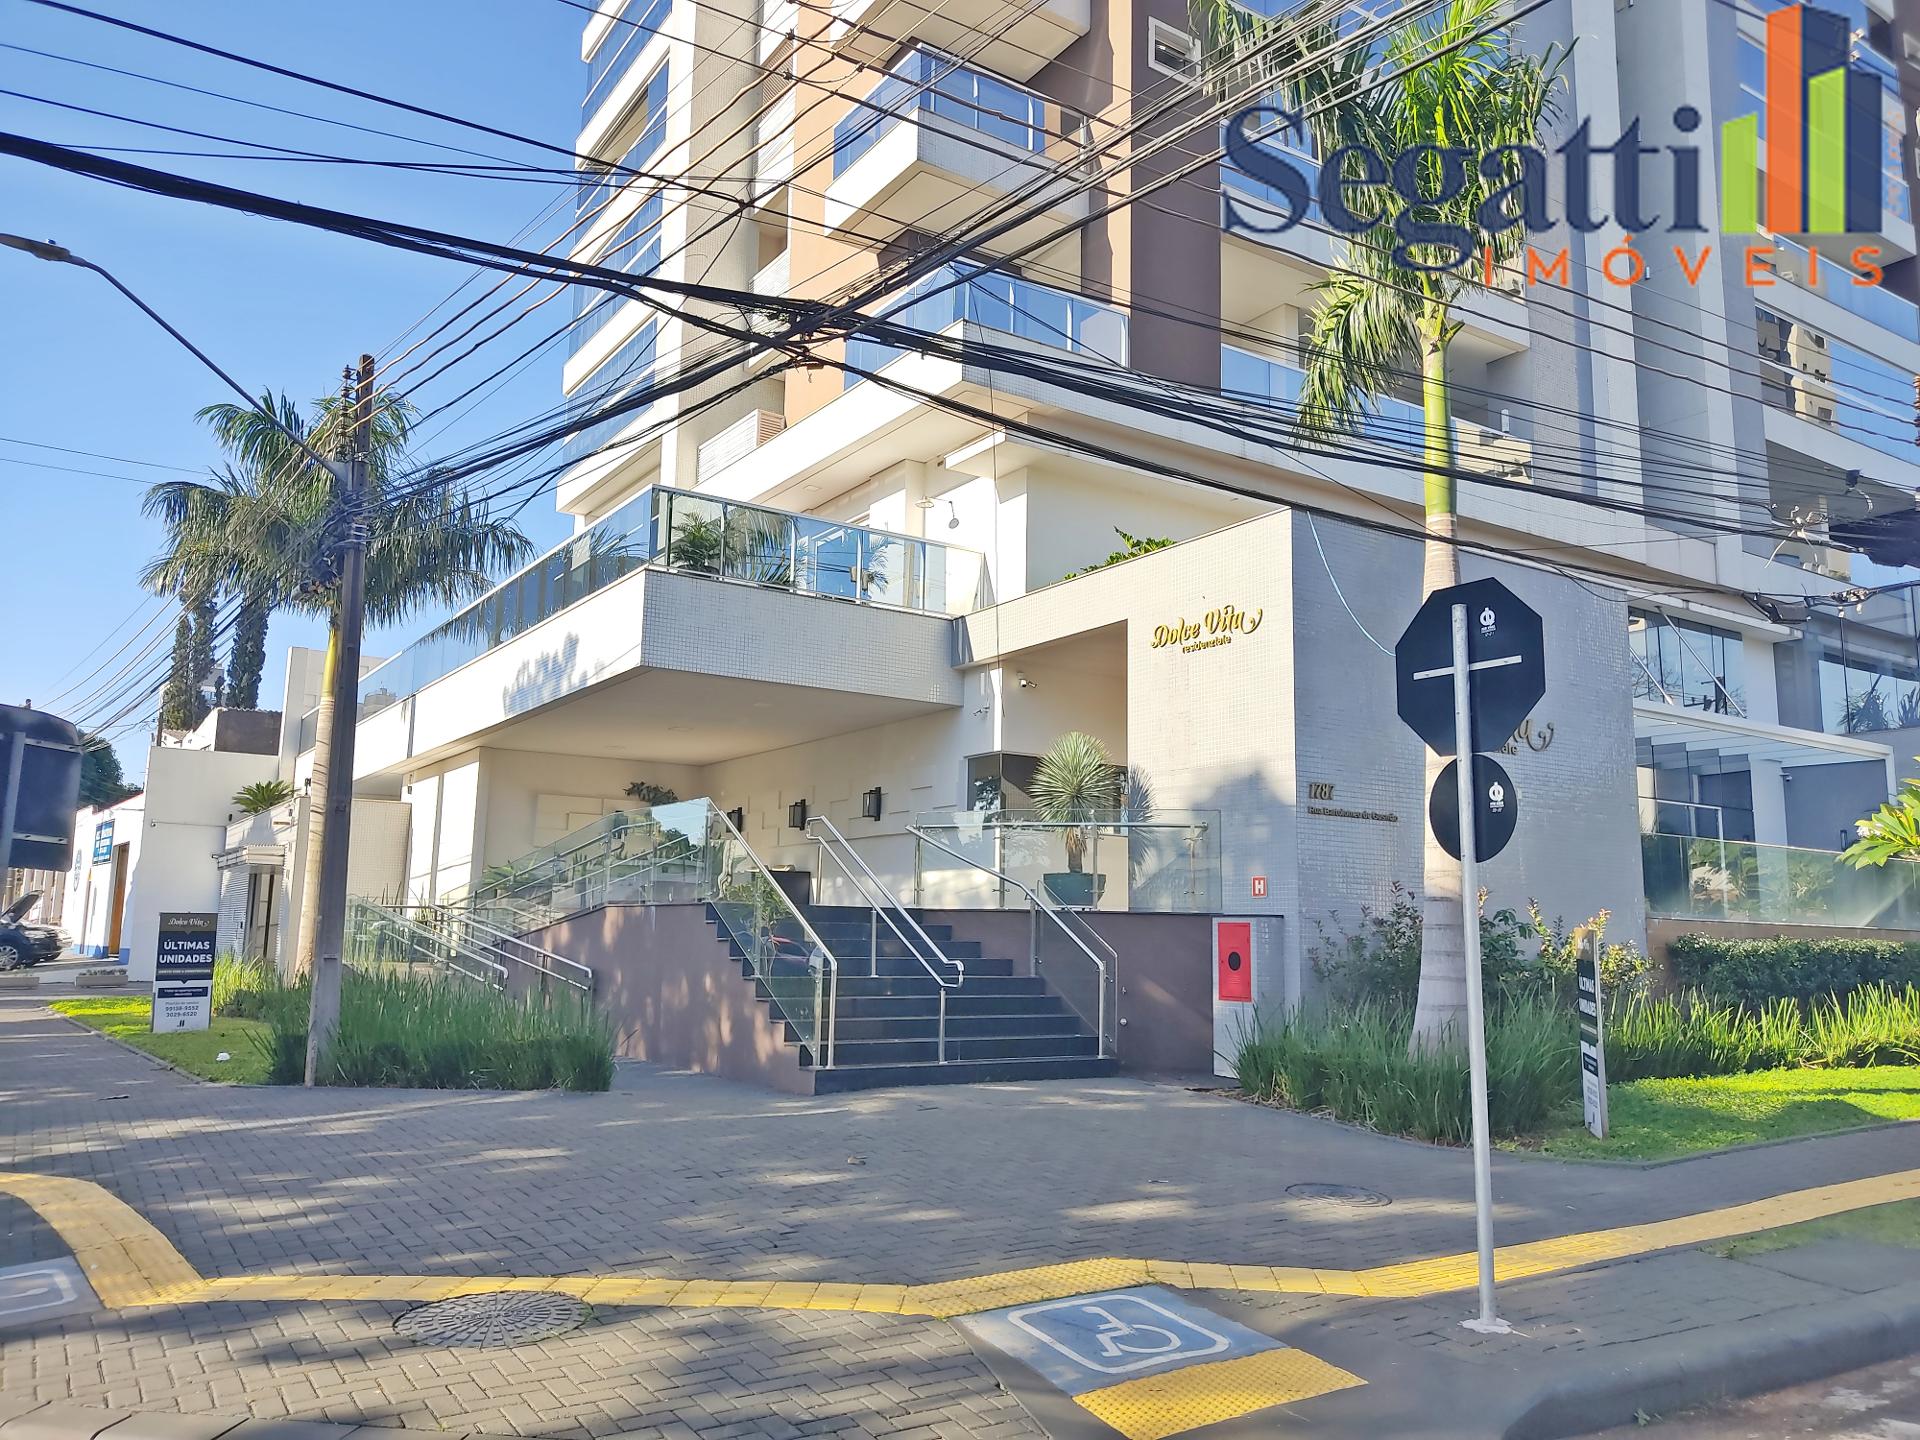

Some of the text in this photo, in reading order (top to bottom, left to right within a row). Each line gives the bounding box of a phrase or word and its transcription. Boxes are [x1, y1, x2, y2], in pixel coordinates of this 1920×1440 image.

[1151, 604, 1263, 649] Dolce Vita
[1182, 635, 1232, 654] residenziale
[1309, 782, 1334, 800] 1787
[1308, 806, 1323, 814] Rua
[1254, 880, 1265, 894] H
[164, 938, 210, 950] ÚLTIMAS
[159, 954, 213, 964] UNIDADES
